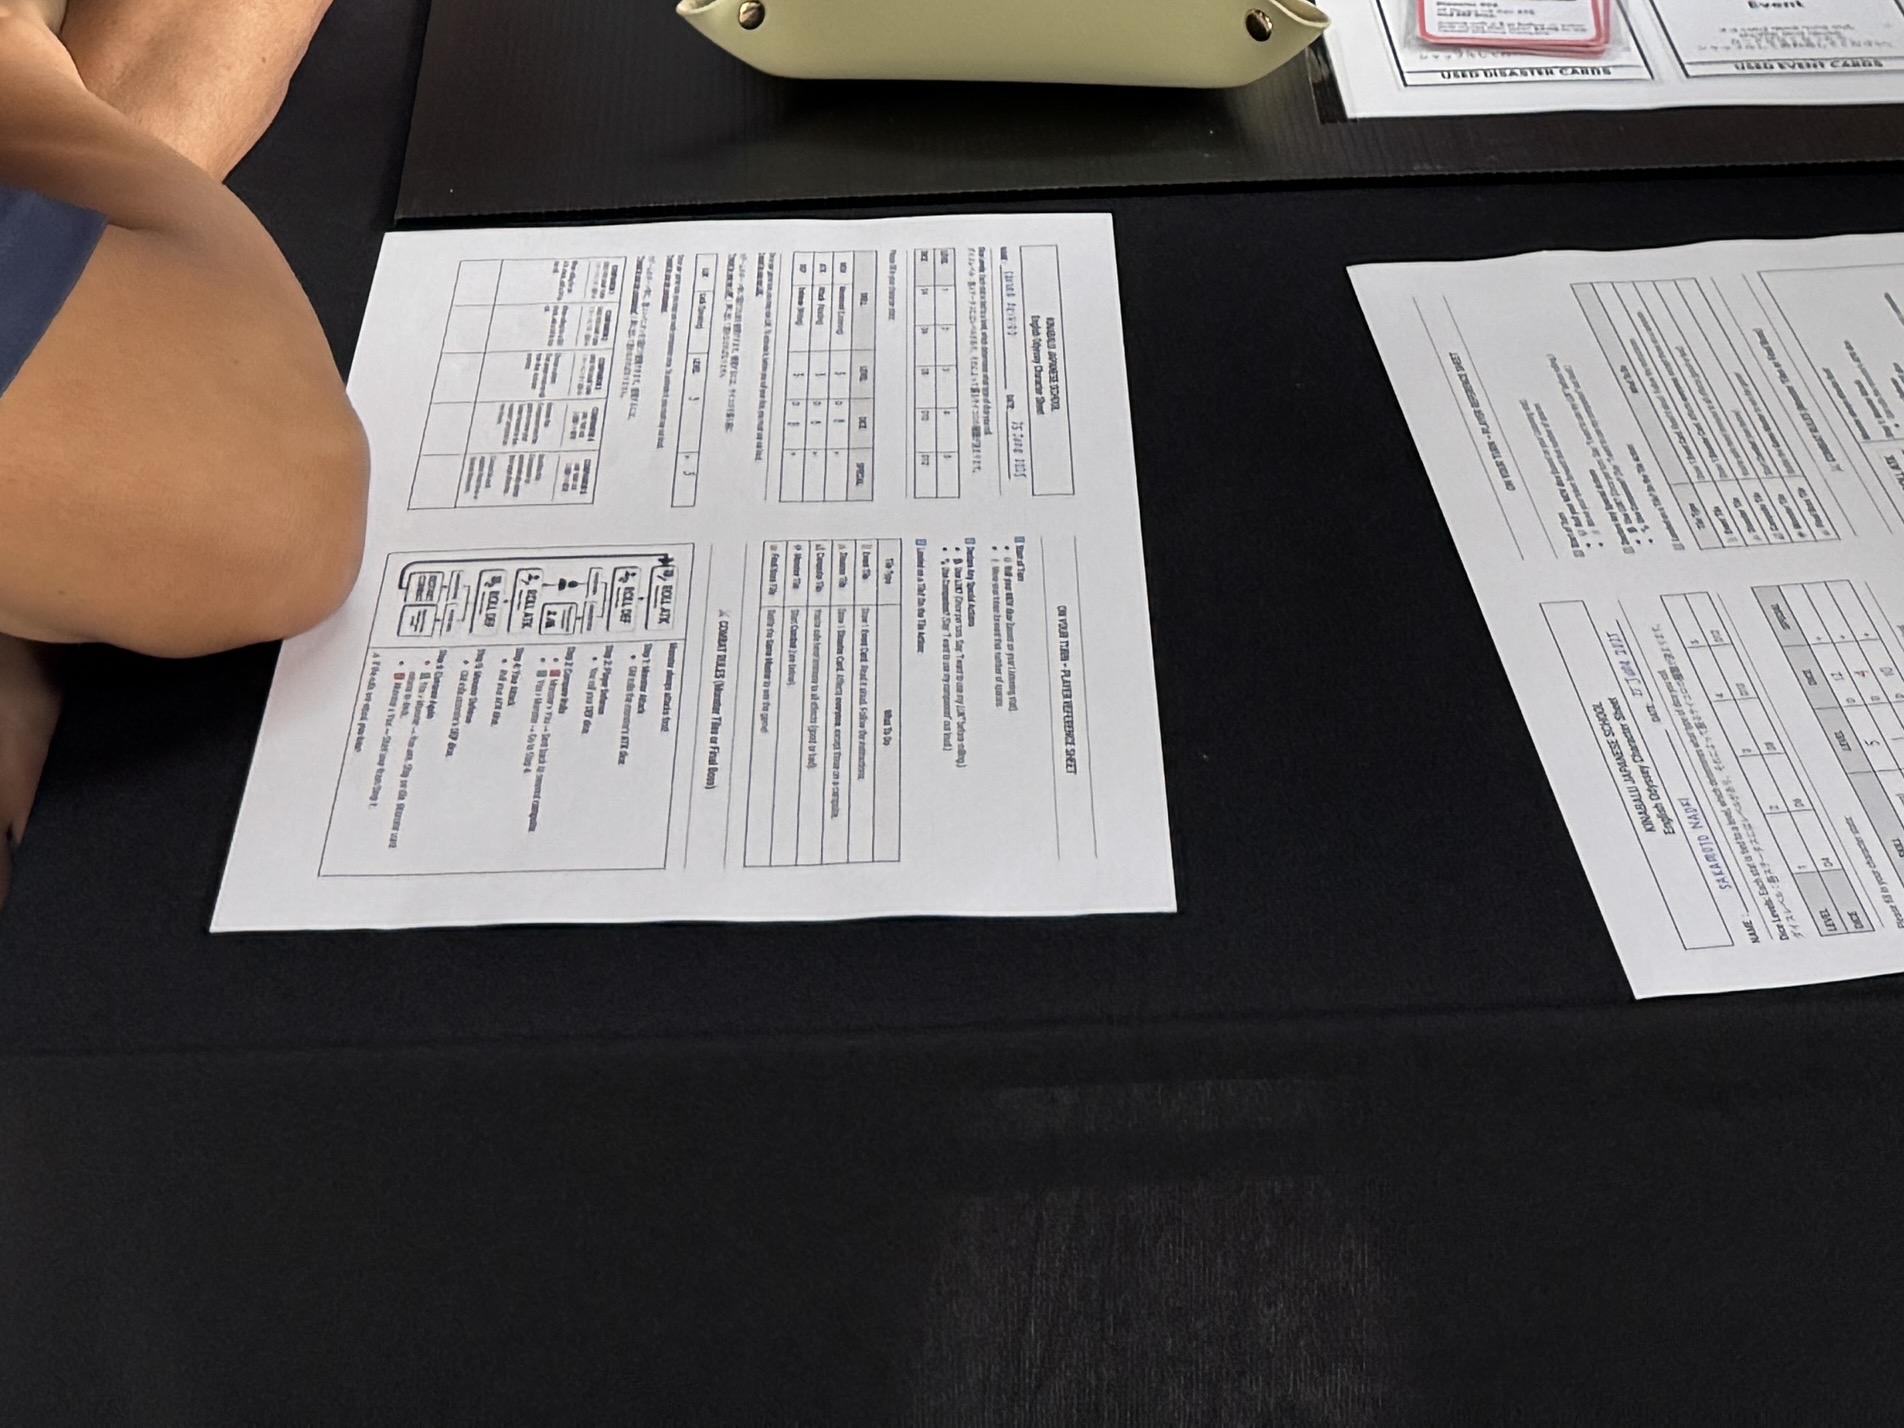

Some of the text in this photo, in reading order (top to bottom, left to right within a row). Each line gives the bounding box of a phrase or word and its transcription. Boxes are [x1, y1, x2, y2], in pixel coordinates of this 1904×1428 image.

[1748, 0, 1804, 10] Event
[1605, 696, 1627, 720] Sheet
[1616, 721, 1646, 763] Character
[1589, 701, 1658, 833] KINABALU JAPANESE SCHOOL
[1650, 801, 1678, 835] English
[1741, 918, 1762, 943] NAME
[1772, 922, 1791, 941] Dice
[1817, 907, 1839, 932] LEVEL
